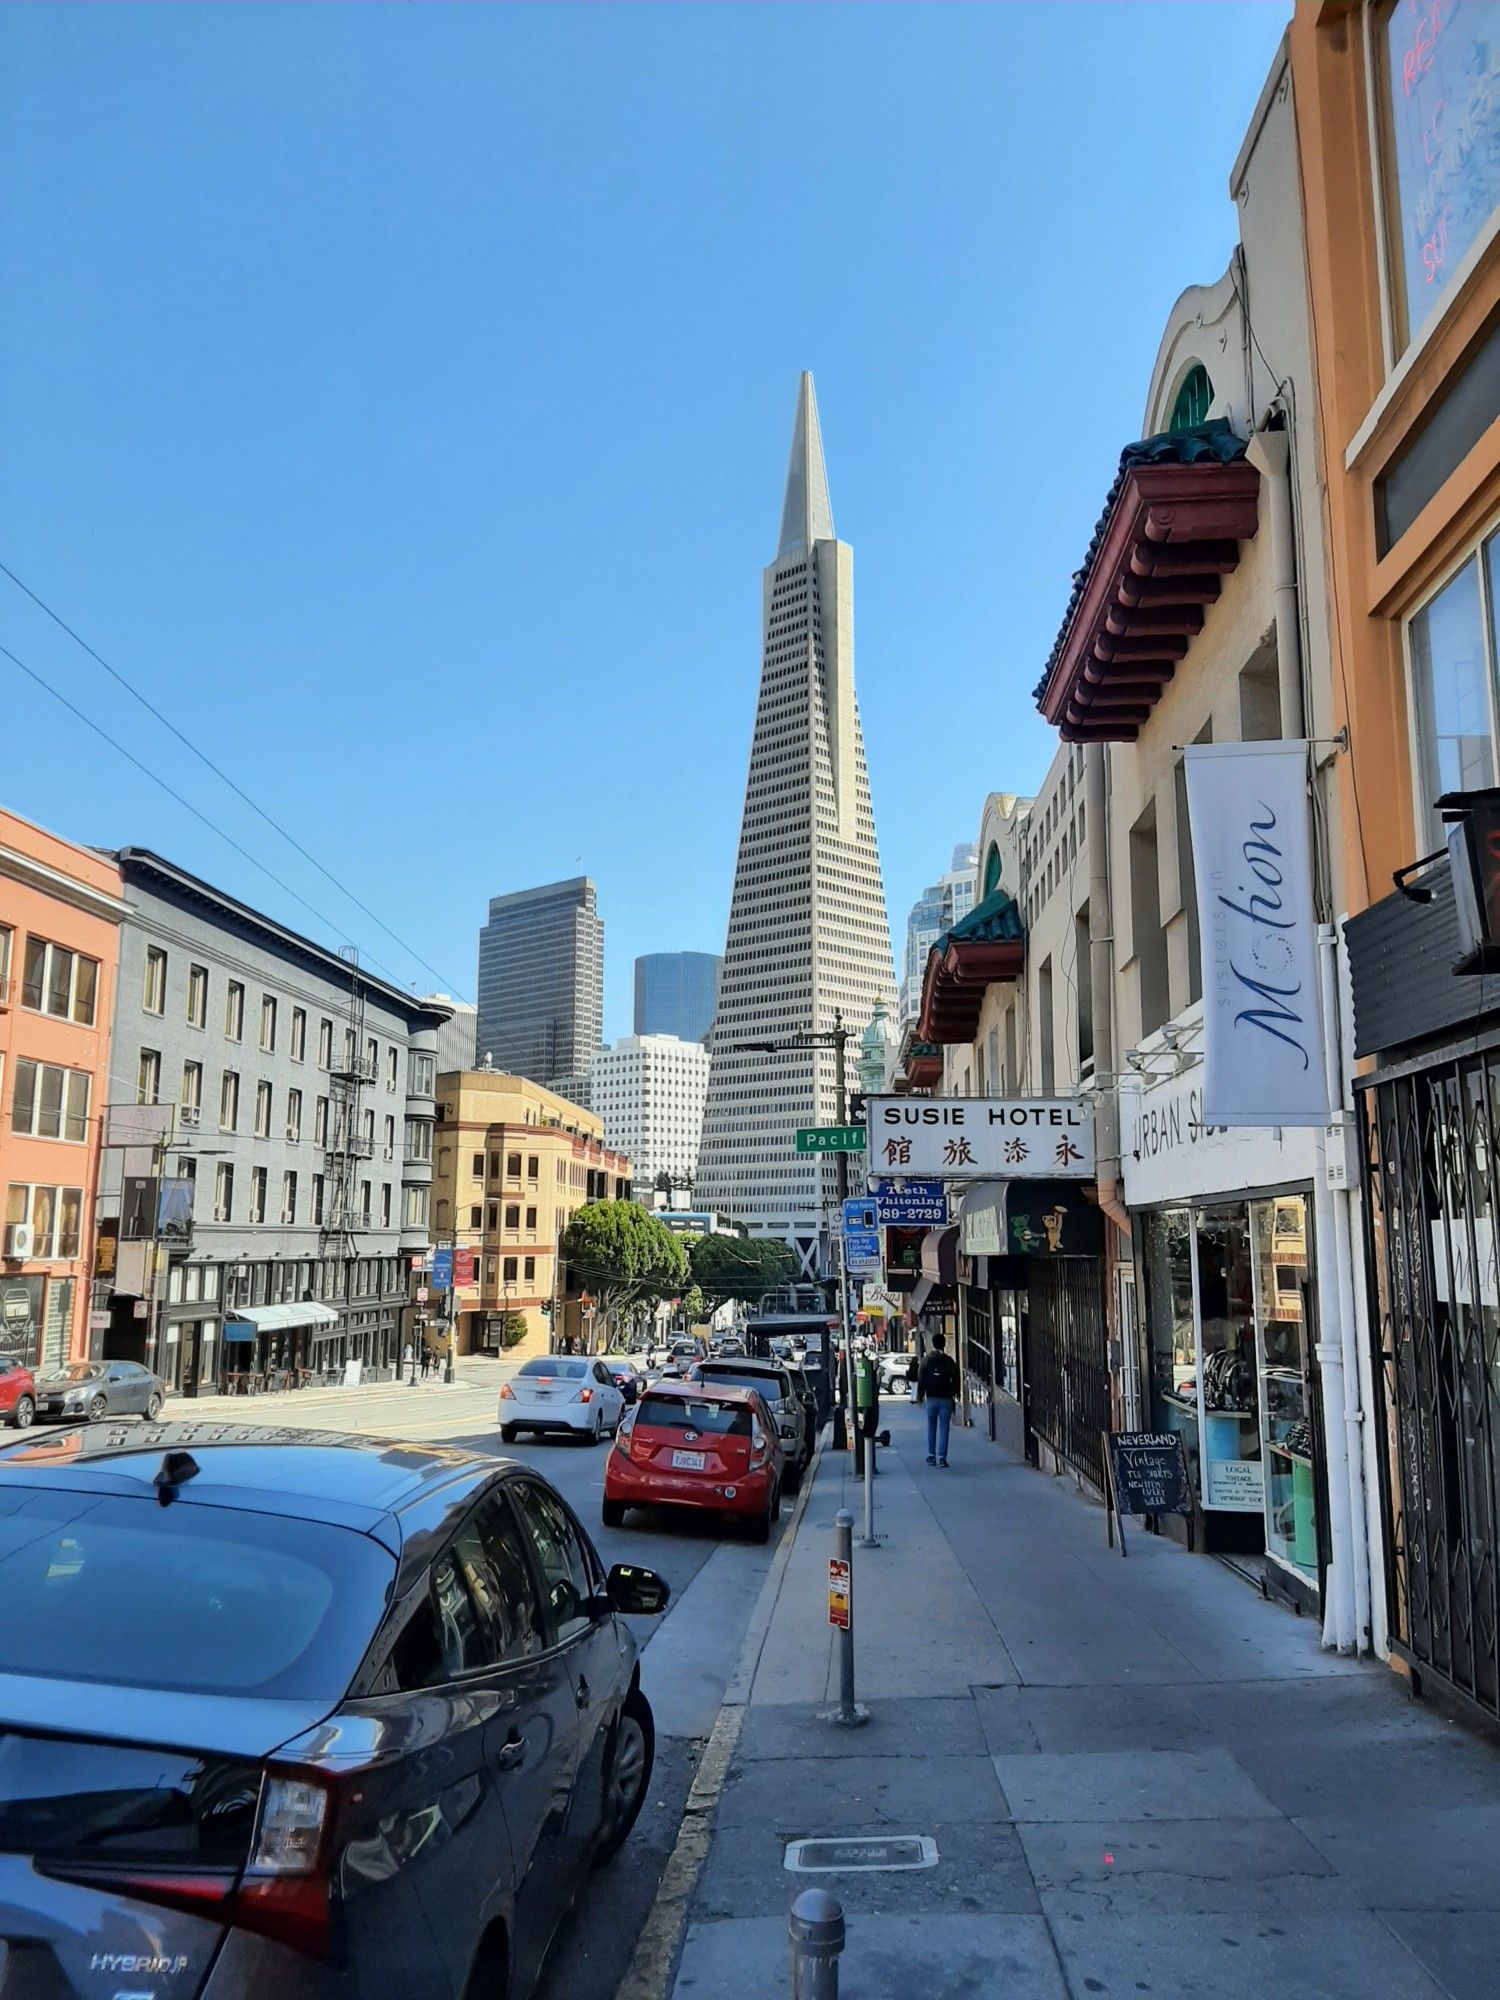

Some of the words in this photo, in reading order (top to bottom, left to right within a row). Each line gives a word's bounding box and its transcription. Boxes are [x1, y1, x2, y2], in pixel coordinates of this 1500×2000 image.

[884, 1108, 964, 1125] SUSIE
[989, 1108, 1081, 1126] HOTEL
[1134, 1096, 1184, 1159] URBAN
[1117, 1433, 1177, 1446] NEVERLAND
[1123, 1451, 1167, 1470] Vintage
